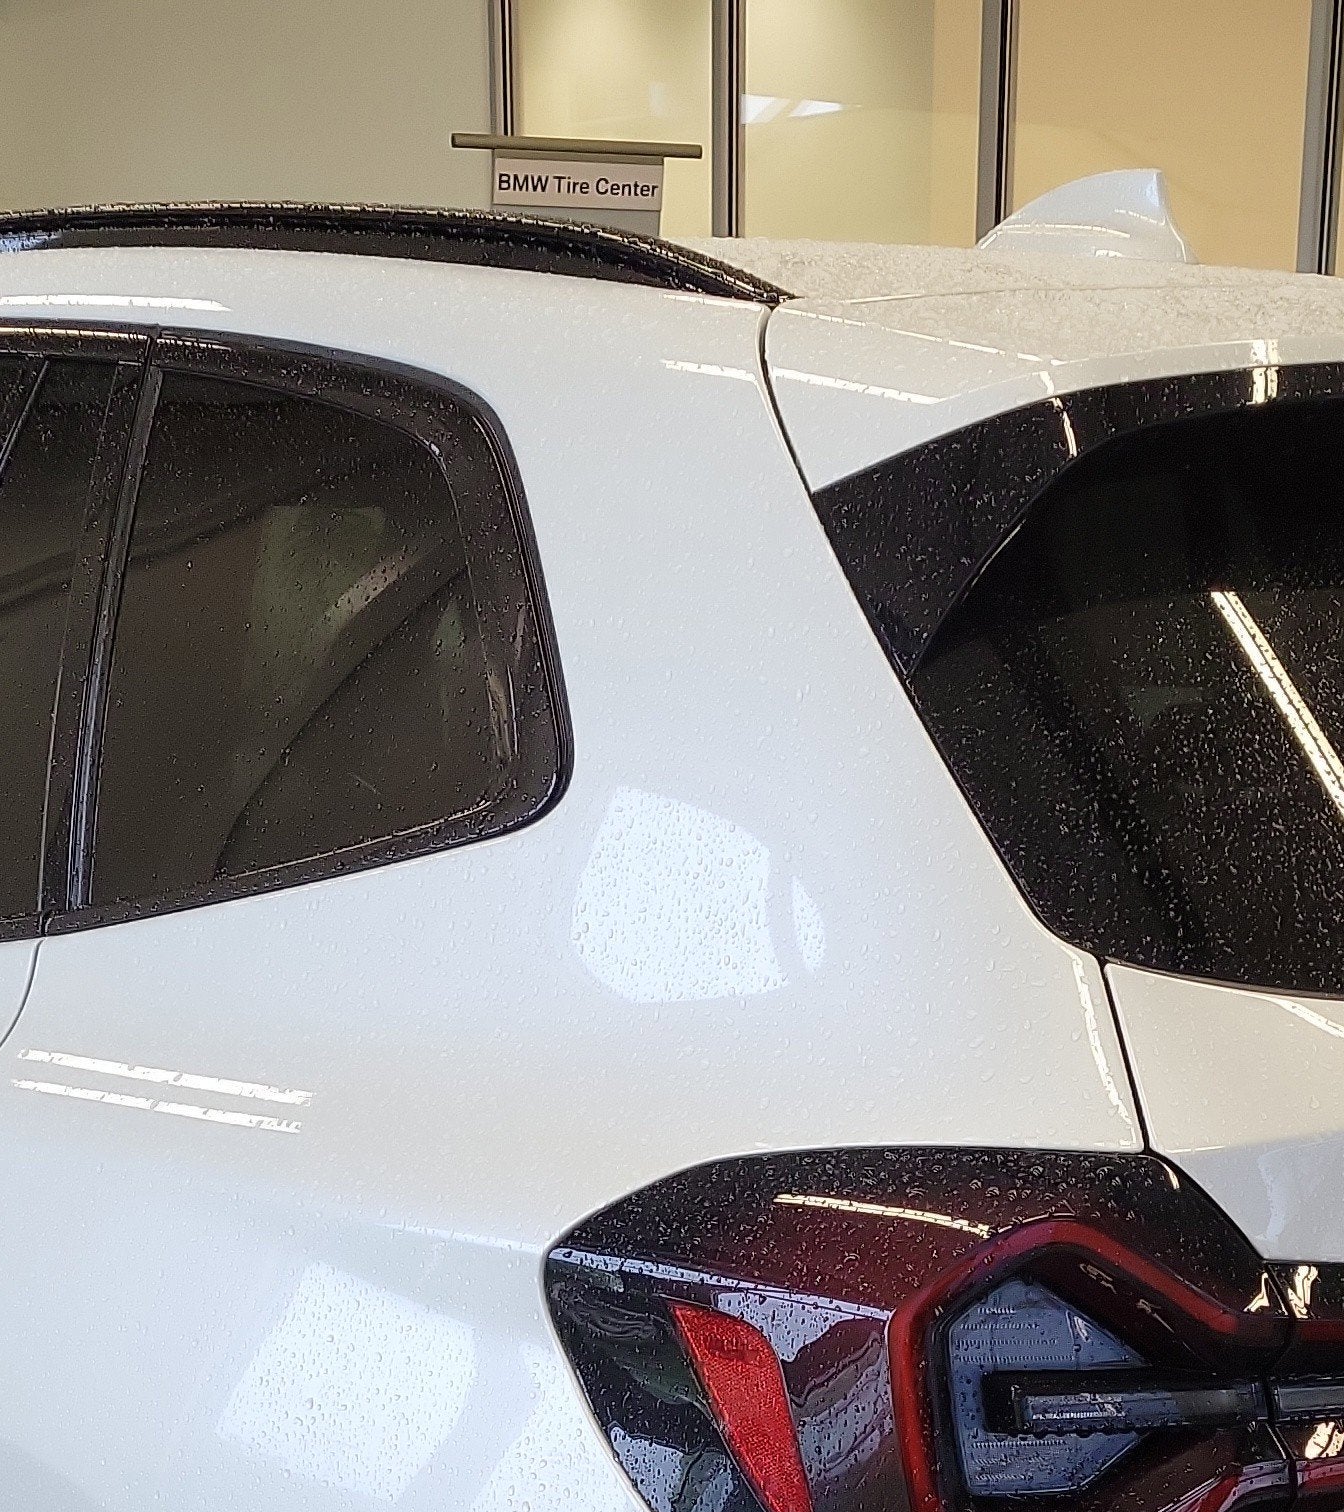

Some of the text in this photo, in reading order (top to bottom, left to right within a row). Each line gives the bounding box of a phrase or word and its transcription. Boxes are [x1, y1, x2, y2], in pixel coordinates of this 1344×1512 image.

[498, 173, 659, 197] BMW Tire Center
